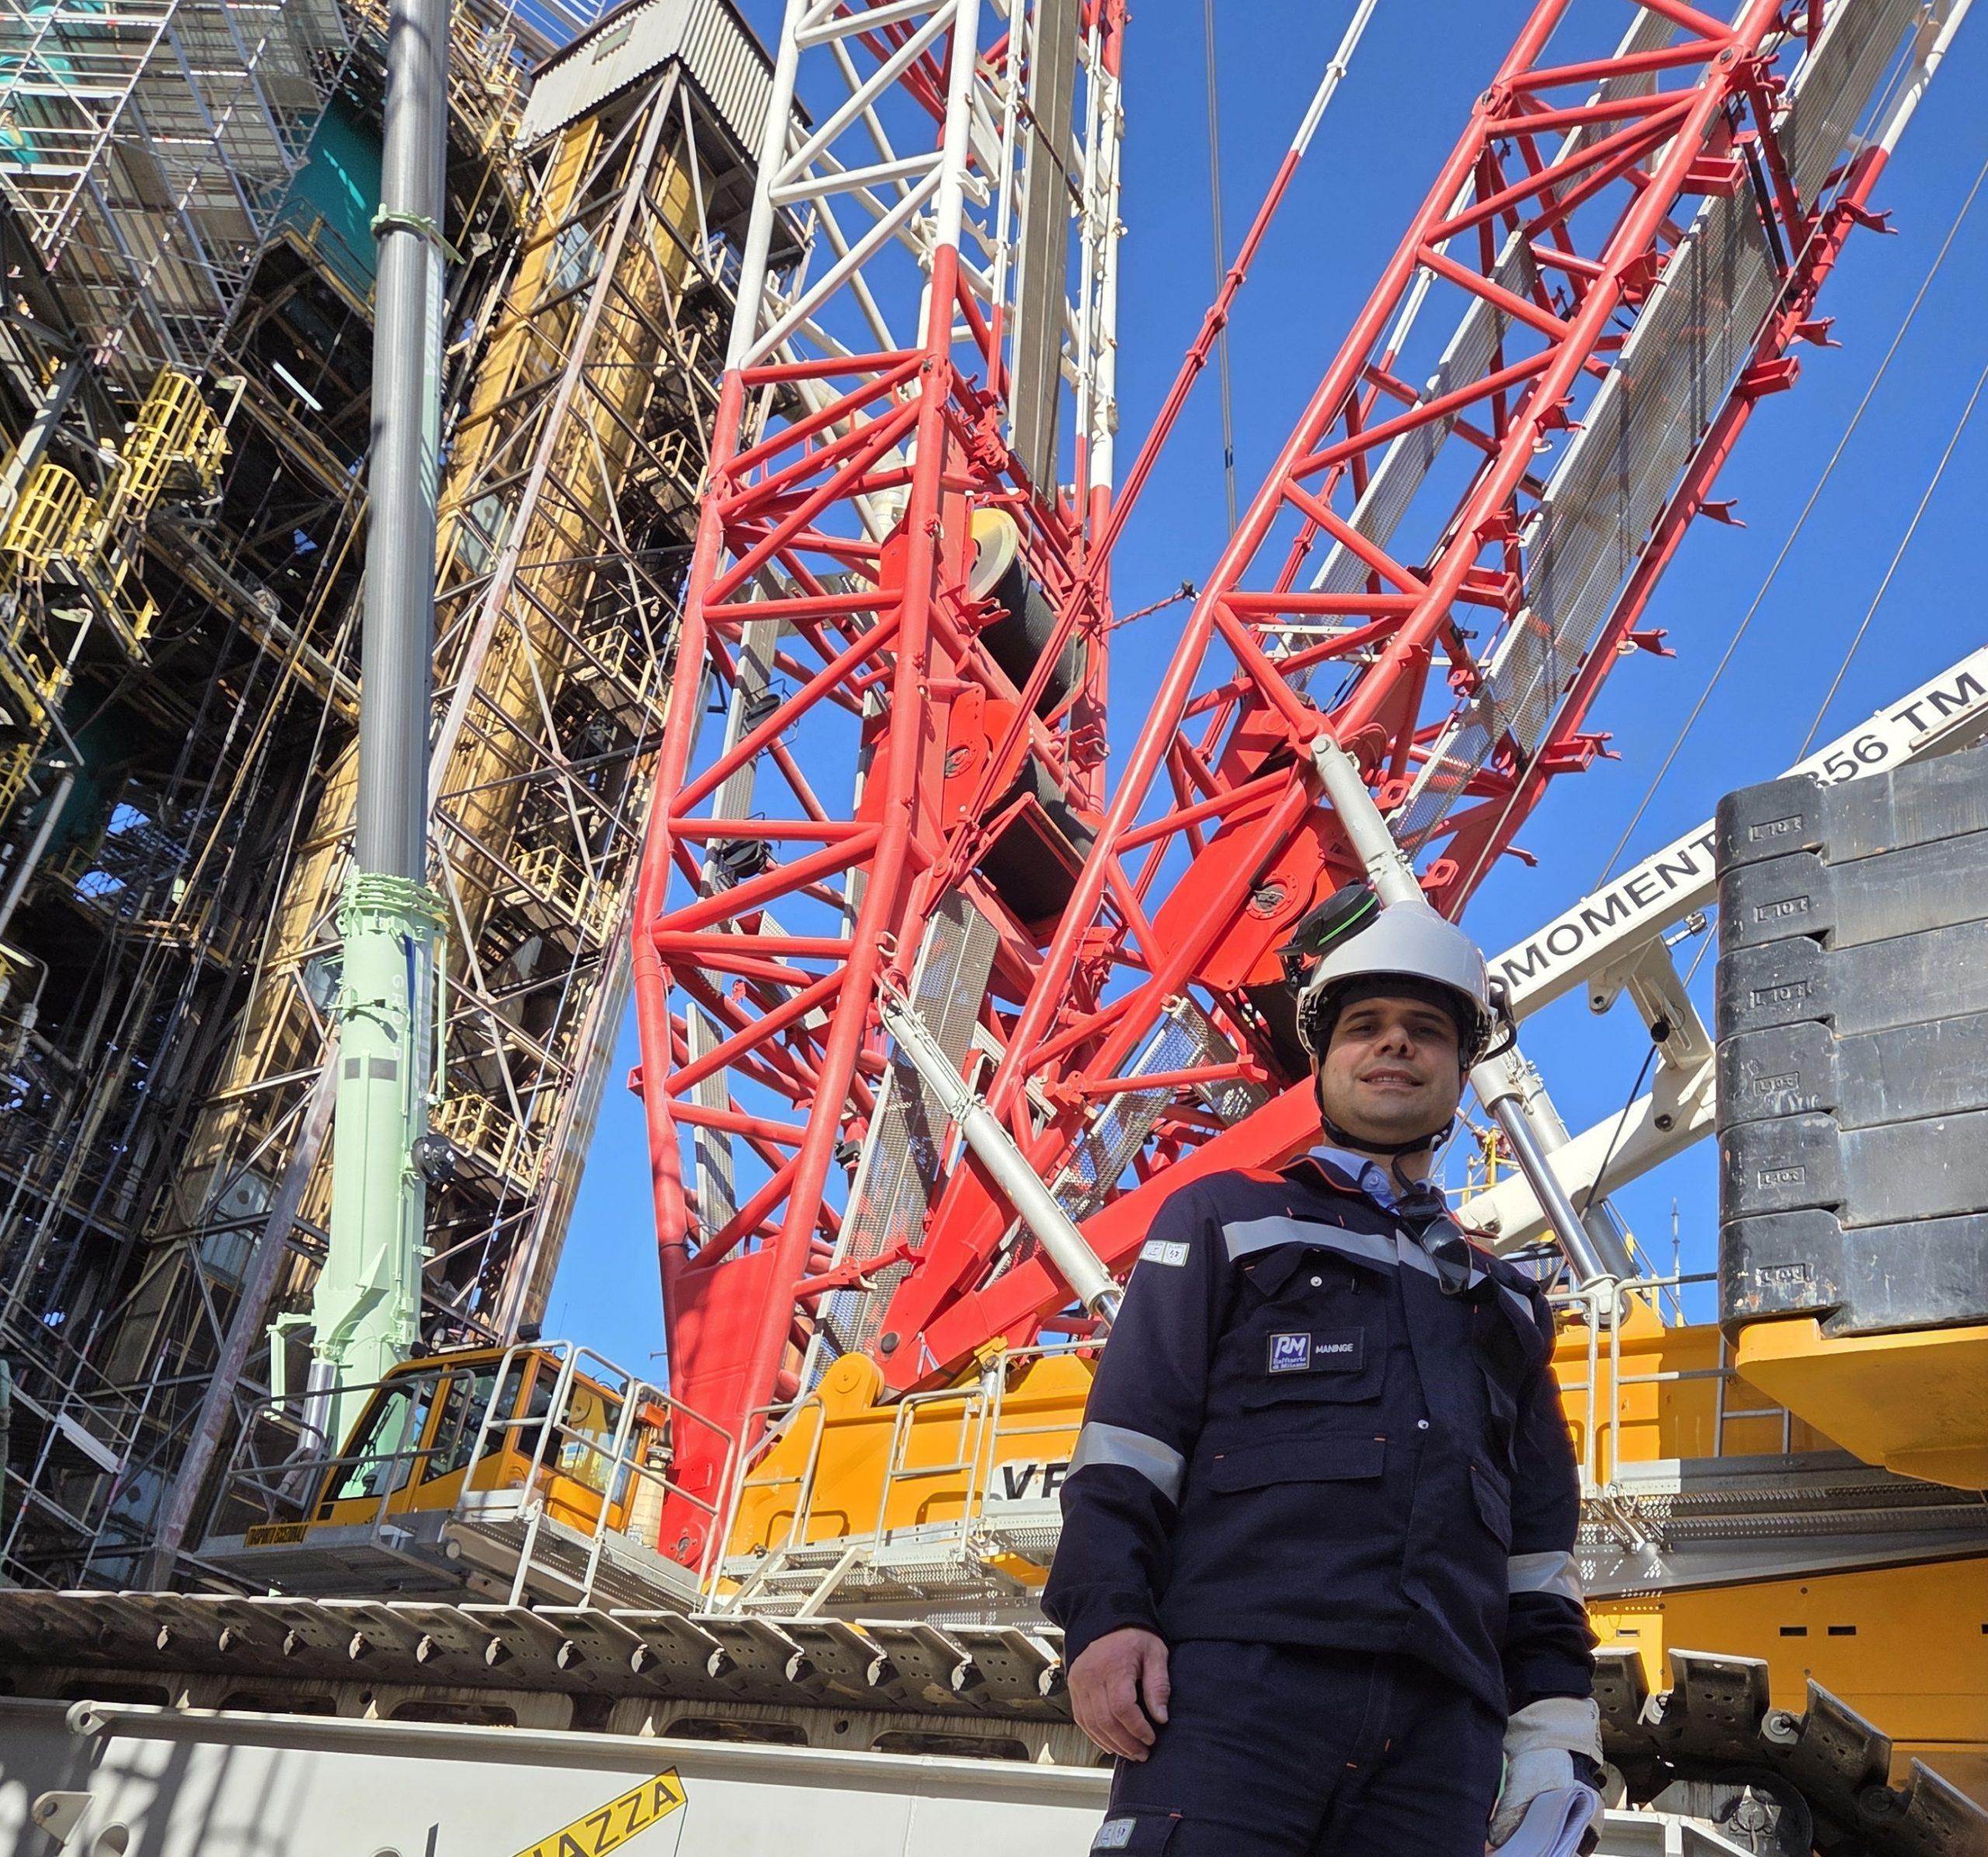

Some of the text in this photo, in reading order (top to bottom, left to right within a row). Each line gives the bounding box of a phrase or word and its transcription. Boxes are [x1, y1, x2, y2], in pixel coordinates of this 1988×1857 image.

[1890, 672, 1987, 732] TM
[1768, 822, 1788, 836] 10
[1775, 902, 1794, 917] 10
